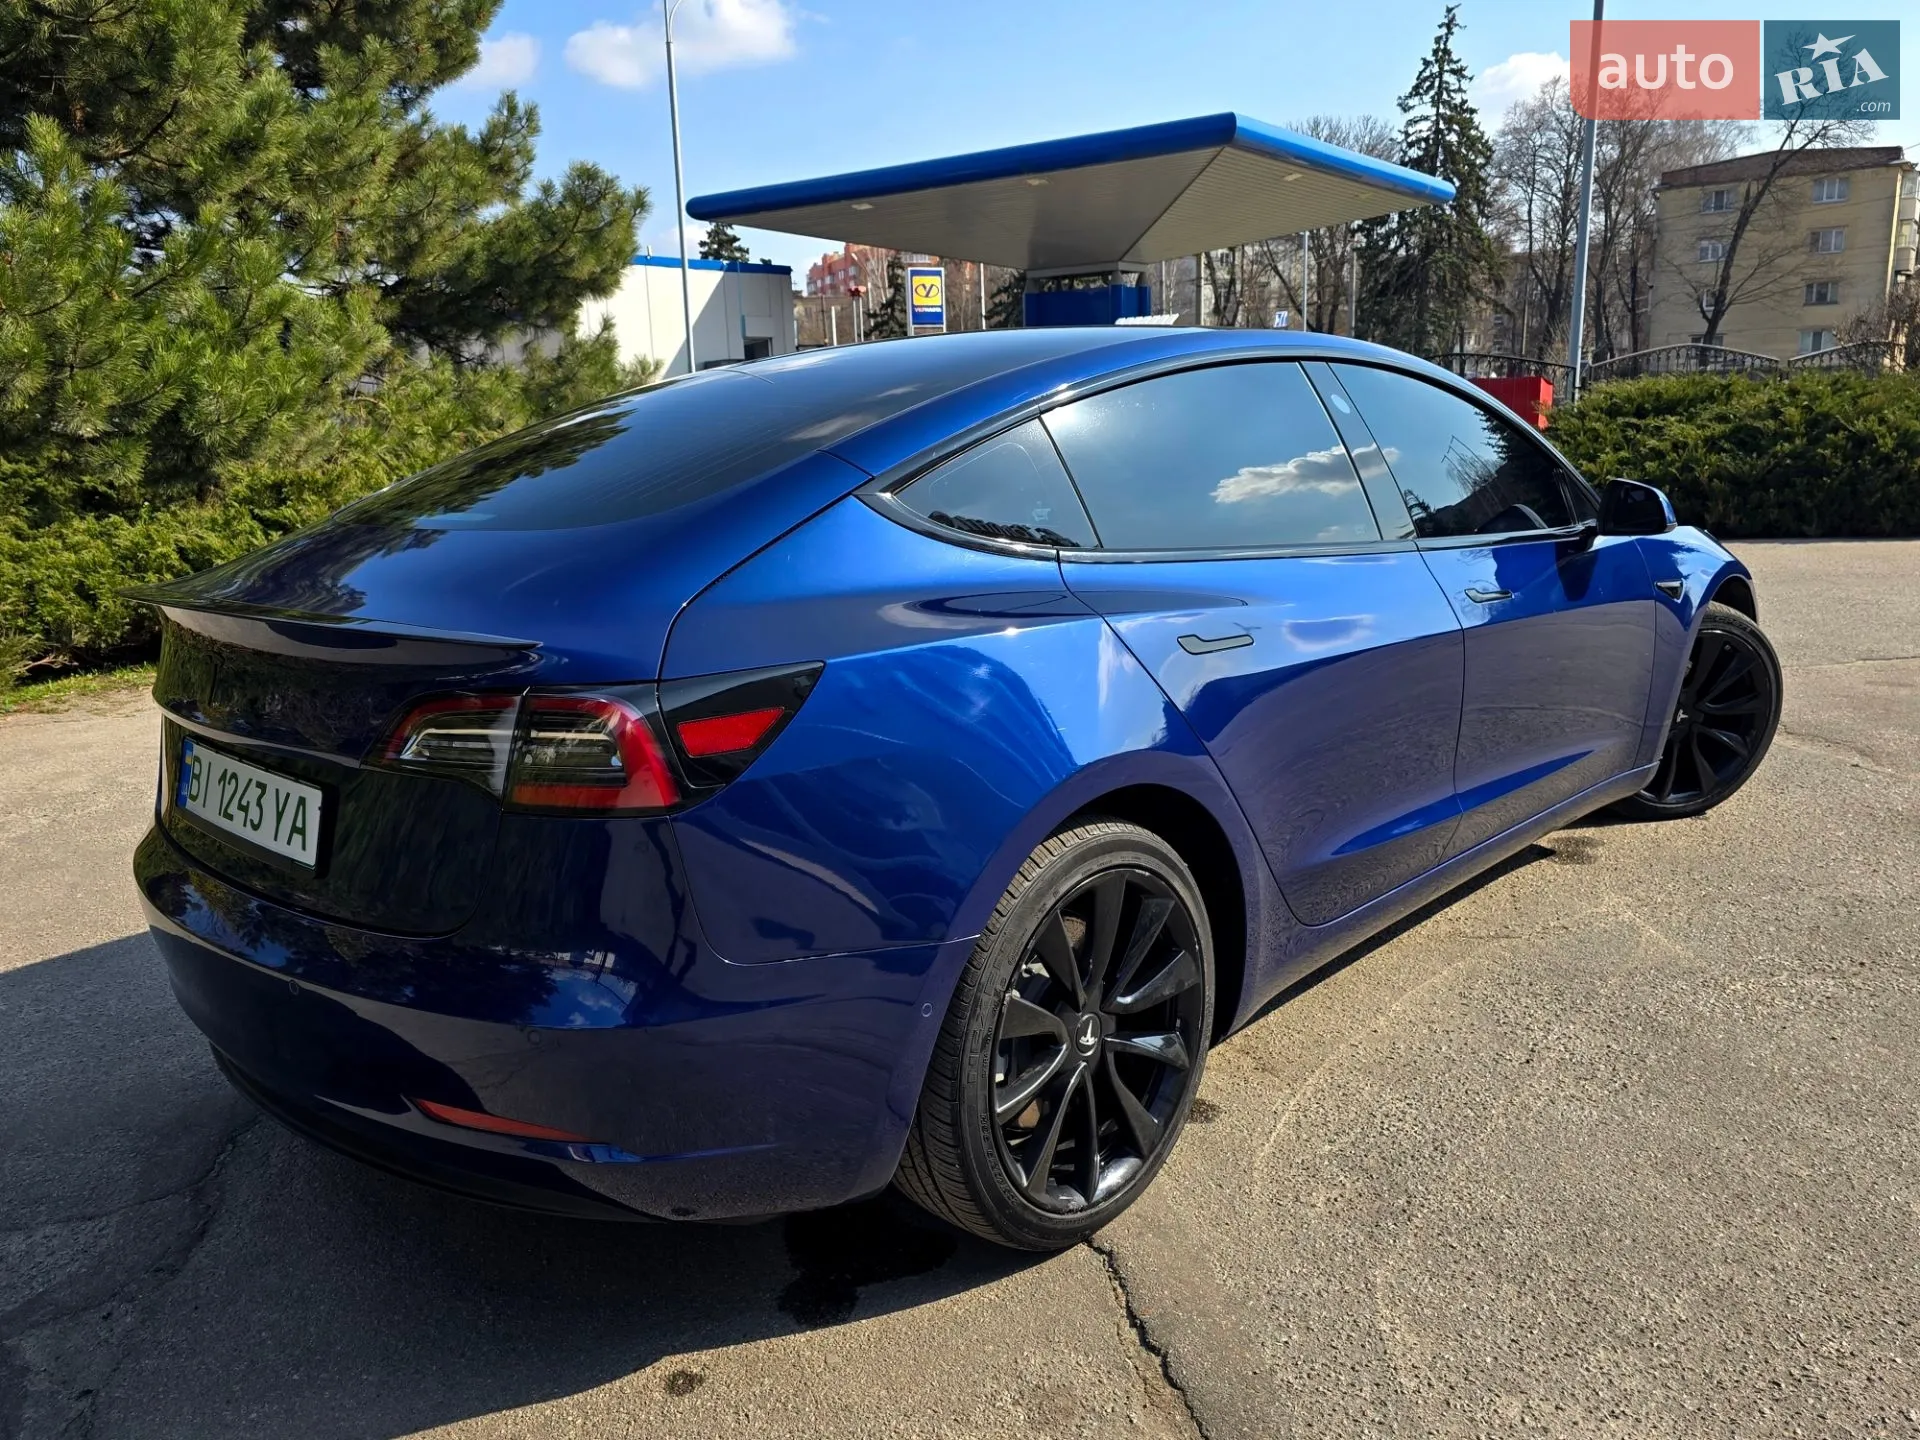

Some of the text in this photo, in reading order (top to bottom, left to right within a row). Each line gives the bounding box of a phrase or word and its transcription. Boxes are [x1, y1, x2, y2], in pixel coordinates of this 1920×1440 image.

[188, 756, 306, 852] BI 1243 YA
